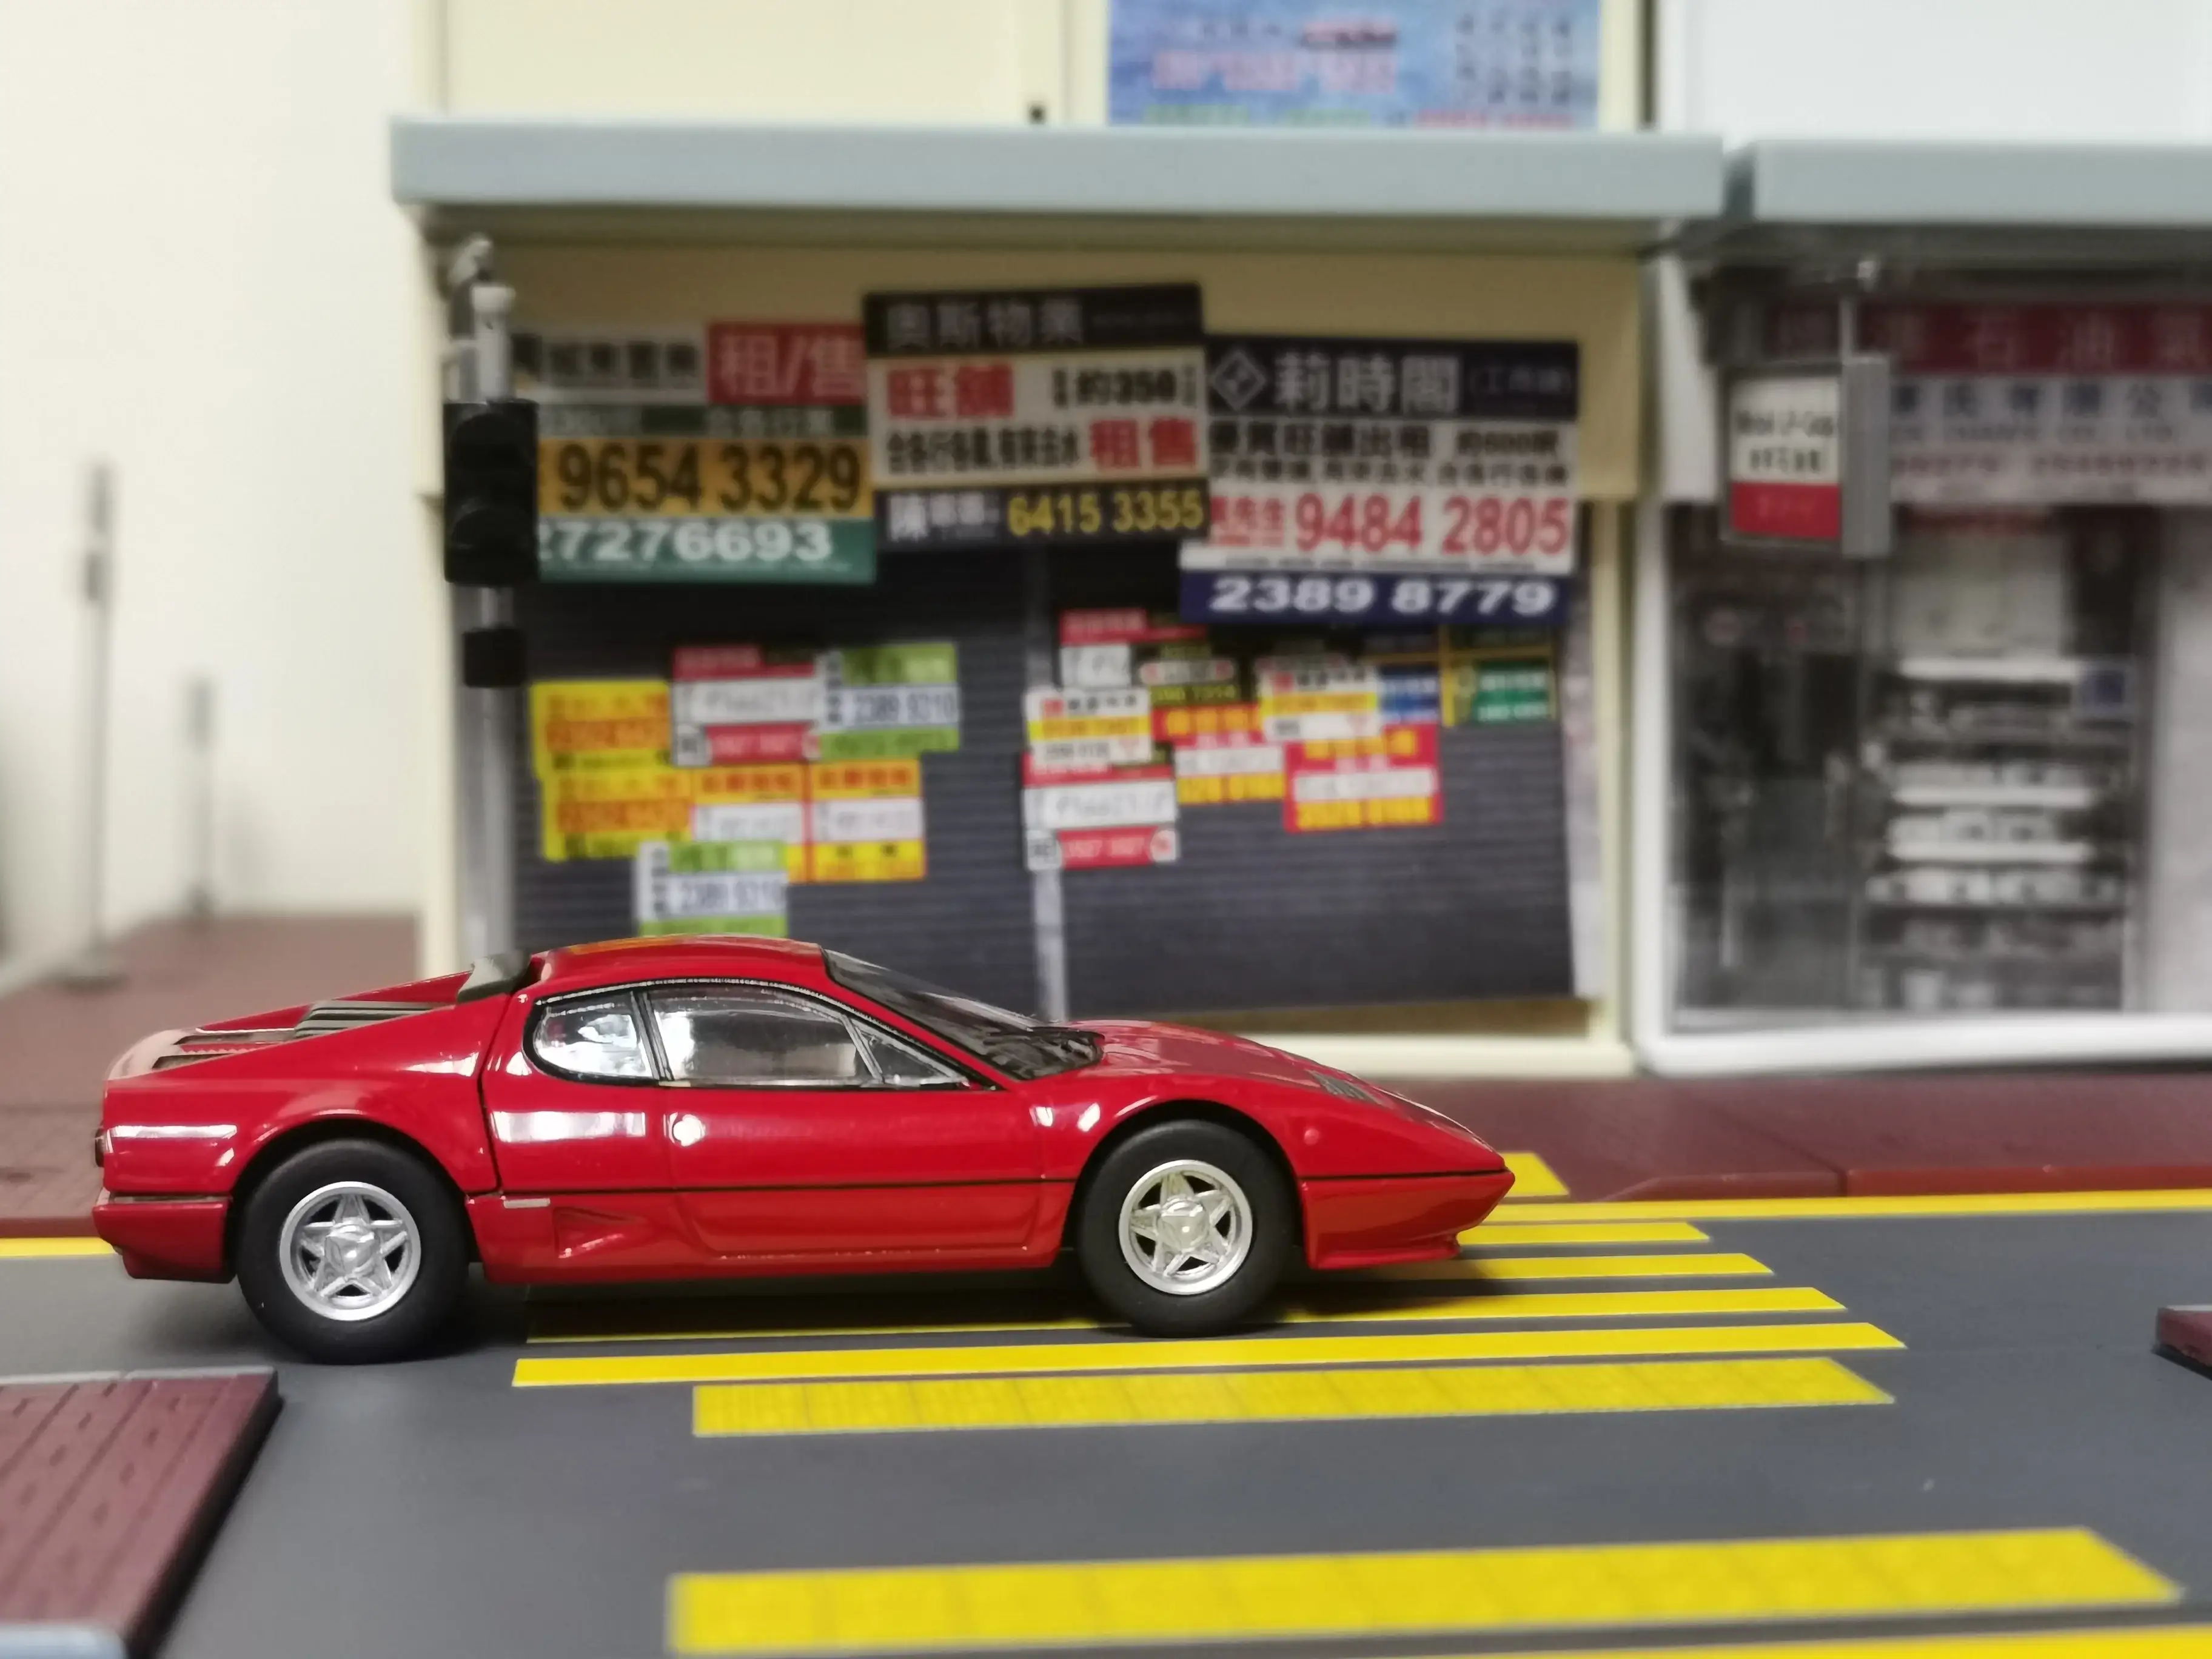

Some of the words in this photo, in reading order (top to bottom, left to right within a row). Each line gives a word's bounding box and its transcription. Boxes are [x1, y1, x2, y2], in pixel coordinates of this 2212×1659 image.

[557, 441, 703, 514] 9654
[720, 441, 862, 514] 3329
[1007, 493, 1101, 536] 6415
[1112, 489, 1204, 534] 3355
[1296, 492, 1423, 552] 9484
[1443, 496, 1570, 555] 2805
[1209, 576, 1376, 614] 2389
[1391, 578, 1557, 615] 8779
